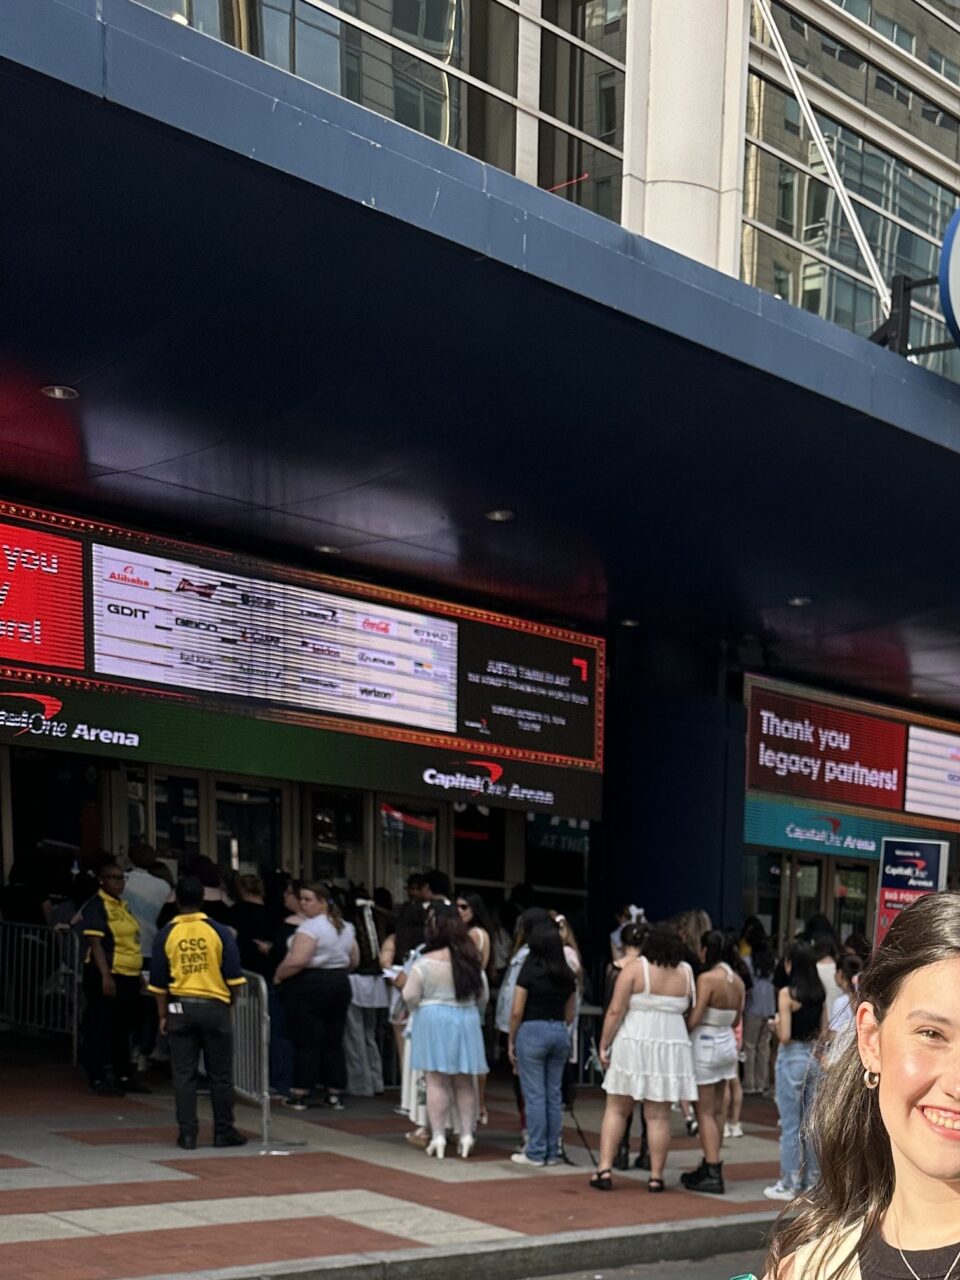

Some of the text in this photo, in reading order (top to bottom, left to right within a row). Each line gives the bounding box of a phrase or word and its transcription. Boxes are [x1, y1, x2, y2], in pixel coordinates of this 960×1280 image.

[3, 544, 58, 574] you
[109, 572, 150, 587] Alibaba
[107, 604, 150, 620] GDIT
[360, 688, 393, 700] verizon
[72, 724, 139, 747] Arena
[759, 709, 850, 751] Thank you
[758, 742, 898, 791] legacy partners!
[423, 768, 482, 792] Capital
[508, 783, 555, 805] Arena
[843, 835, 876, 851] Arena
[885, 865, 912, 877] Capital
[908, 879, 934, 887] Arena
[179, 937, 207, 951] CSC
[181, 952, 208, 963] EVENT
[181, 963, 209, 975] STAFF
